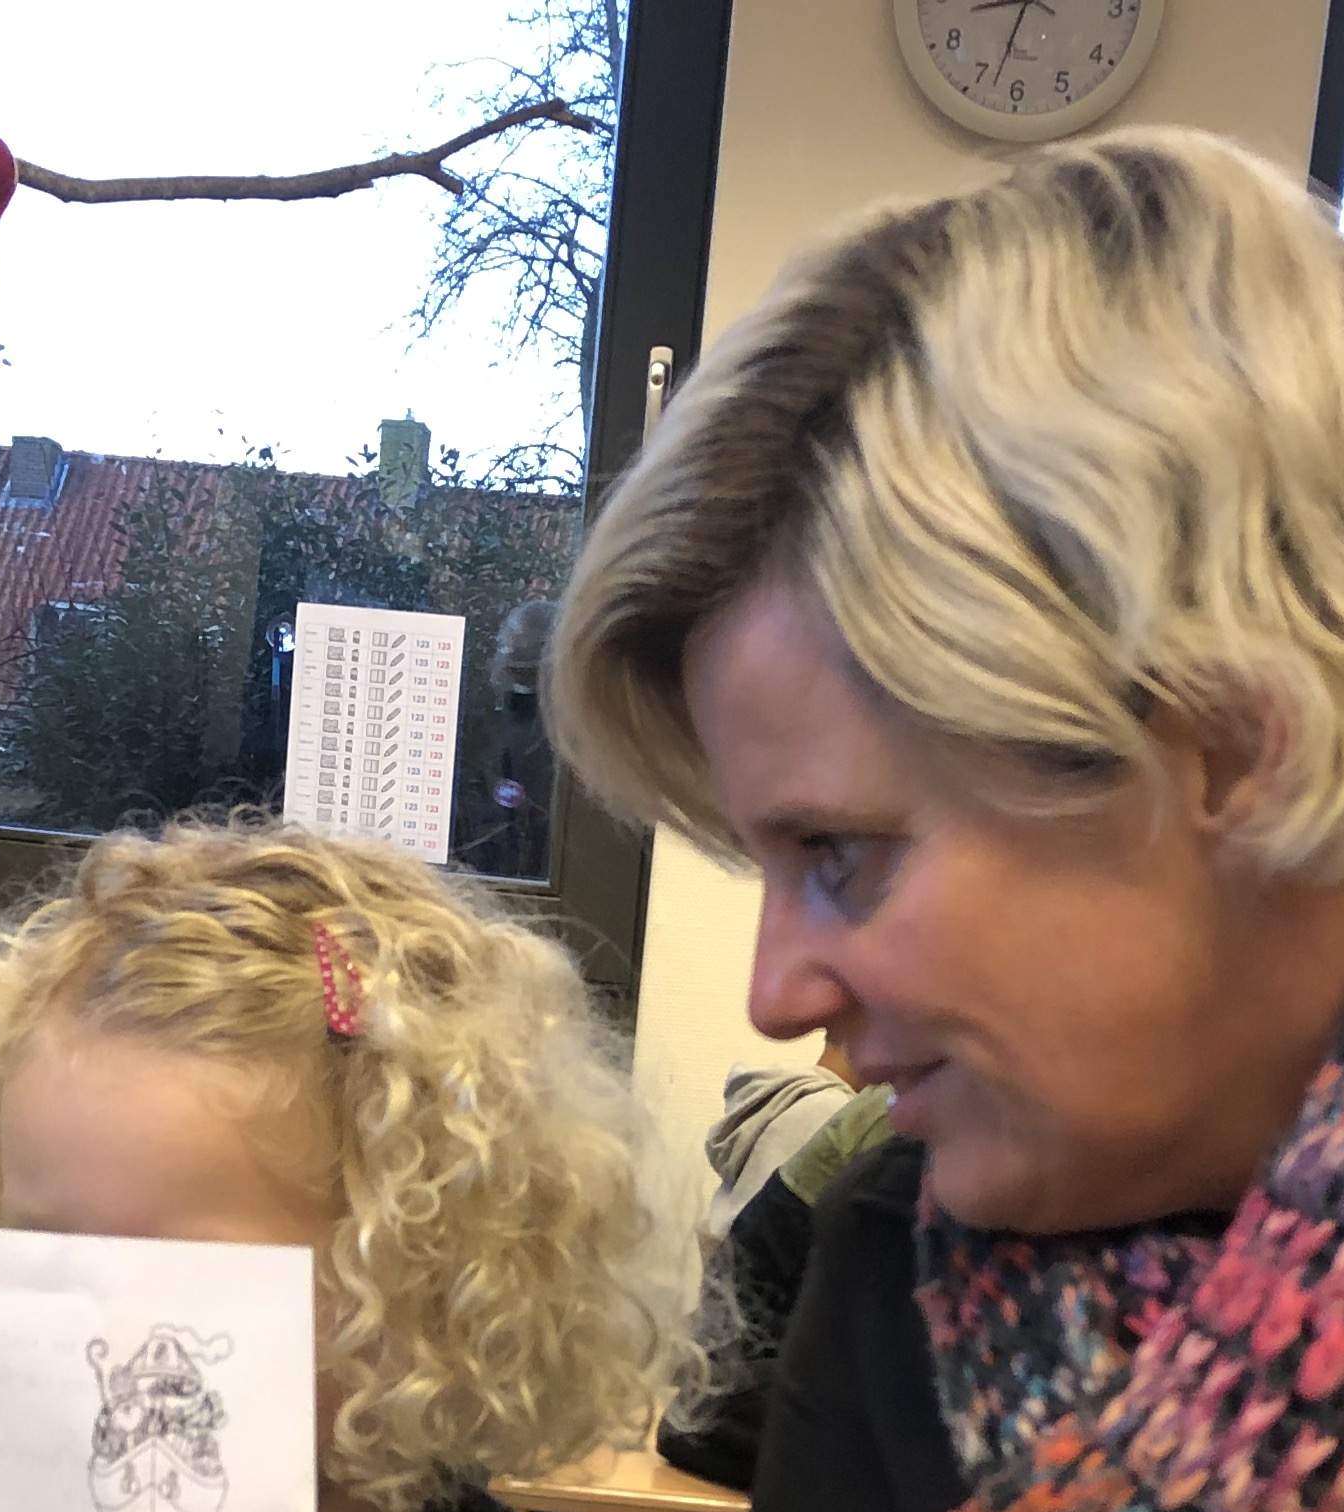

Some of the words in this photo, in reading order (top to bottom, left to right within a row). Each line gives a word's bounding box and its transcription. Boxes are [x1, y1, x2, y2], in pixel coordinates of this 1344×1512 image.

[1108, 0, 1123, 19] 3
[946, 28, 961, 51] 8
[1089, 44, 1102, 64] 4
[975, 62, 989, 84] 7
[1055, 71, 1069, 93] 5
[1010, 79, 1024, 101] 6
[416, 640, 429, 648] 123
[438, 642, 451, 651] 123
[415, 658, 428, 666] 123
[436, 660, 450, 669] 123
[414, 677, 427, 685] 123
[435, 678, 448, 687] 123
[412, 695, 426, 704] 123
[434, 697, 446, 706] 123
[411, 713, 424, 722] 123
[432, 715, 445, 724] 123
